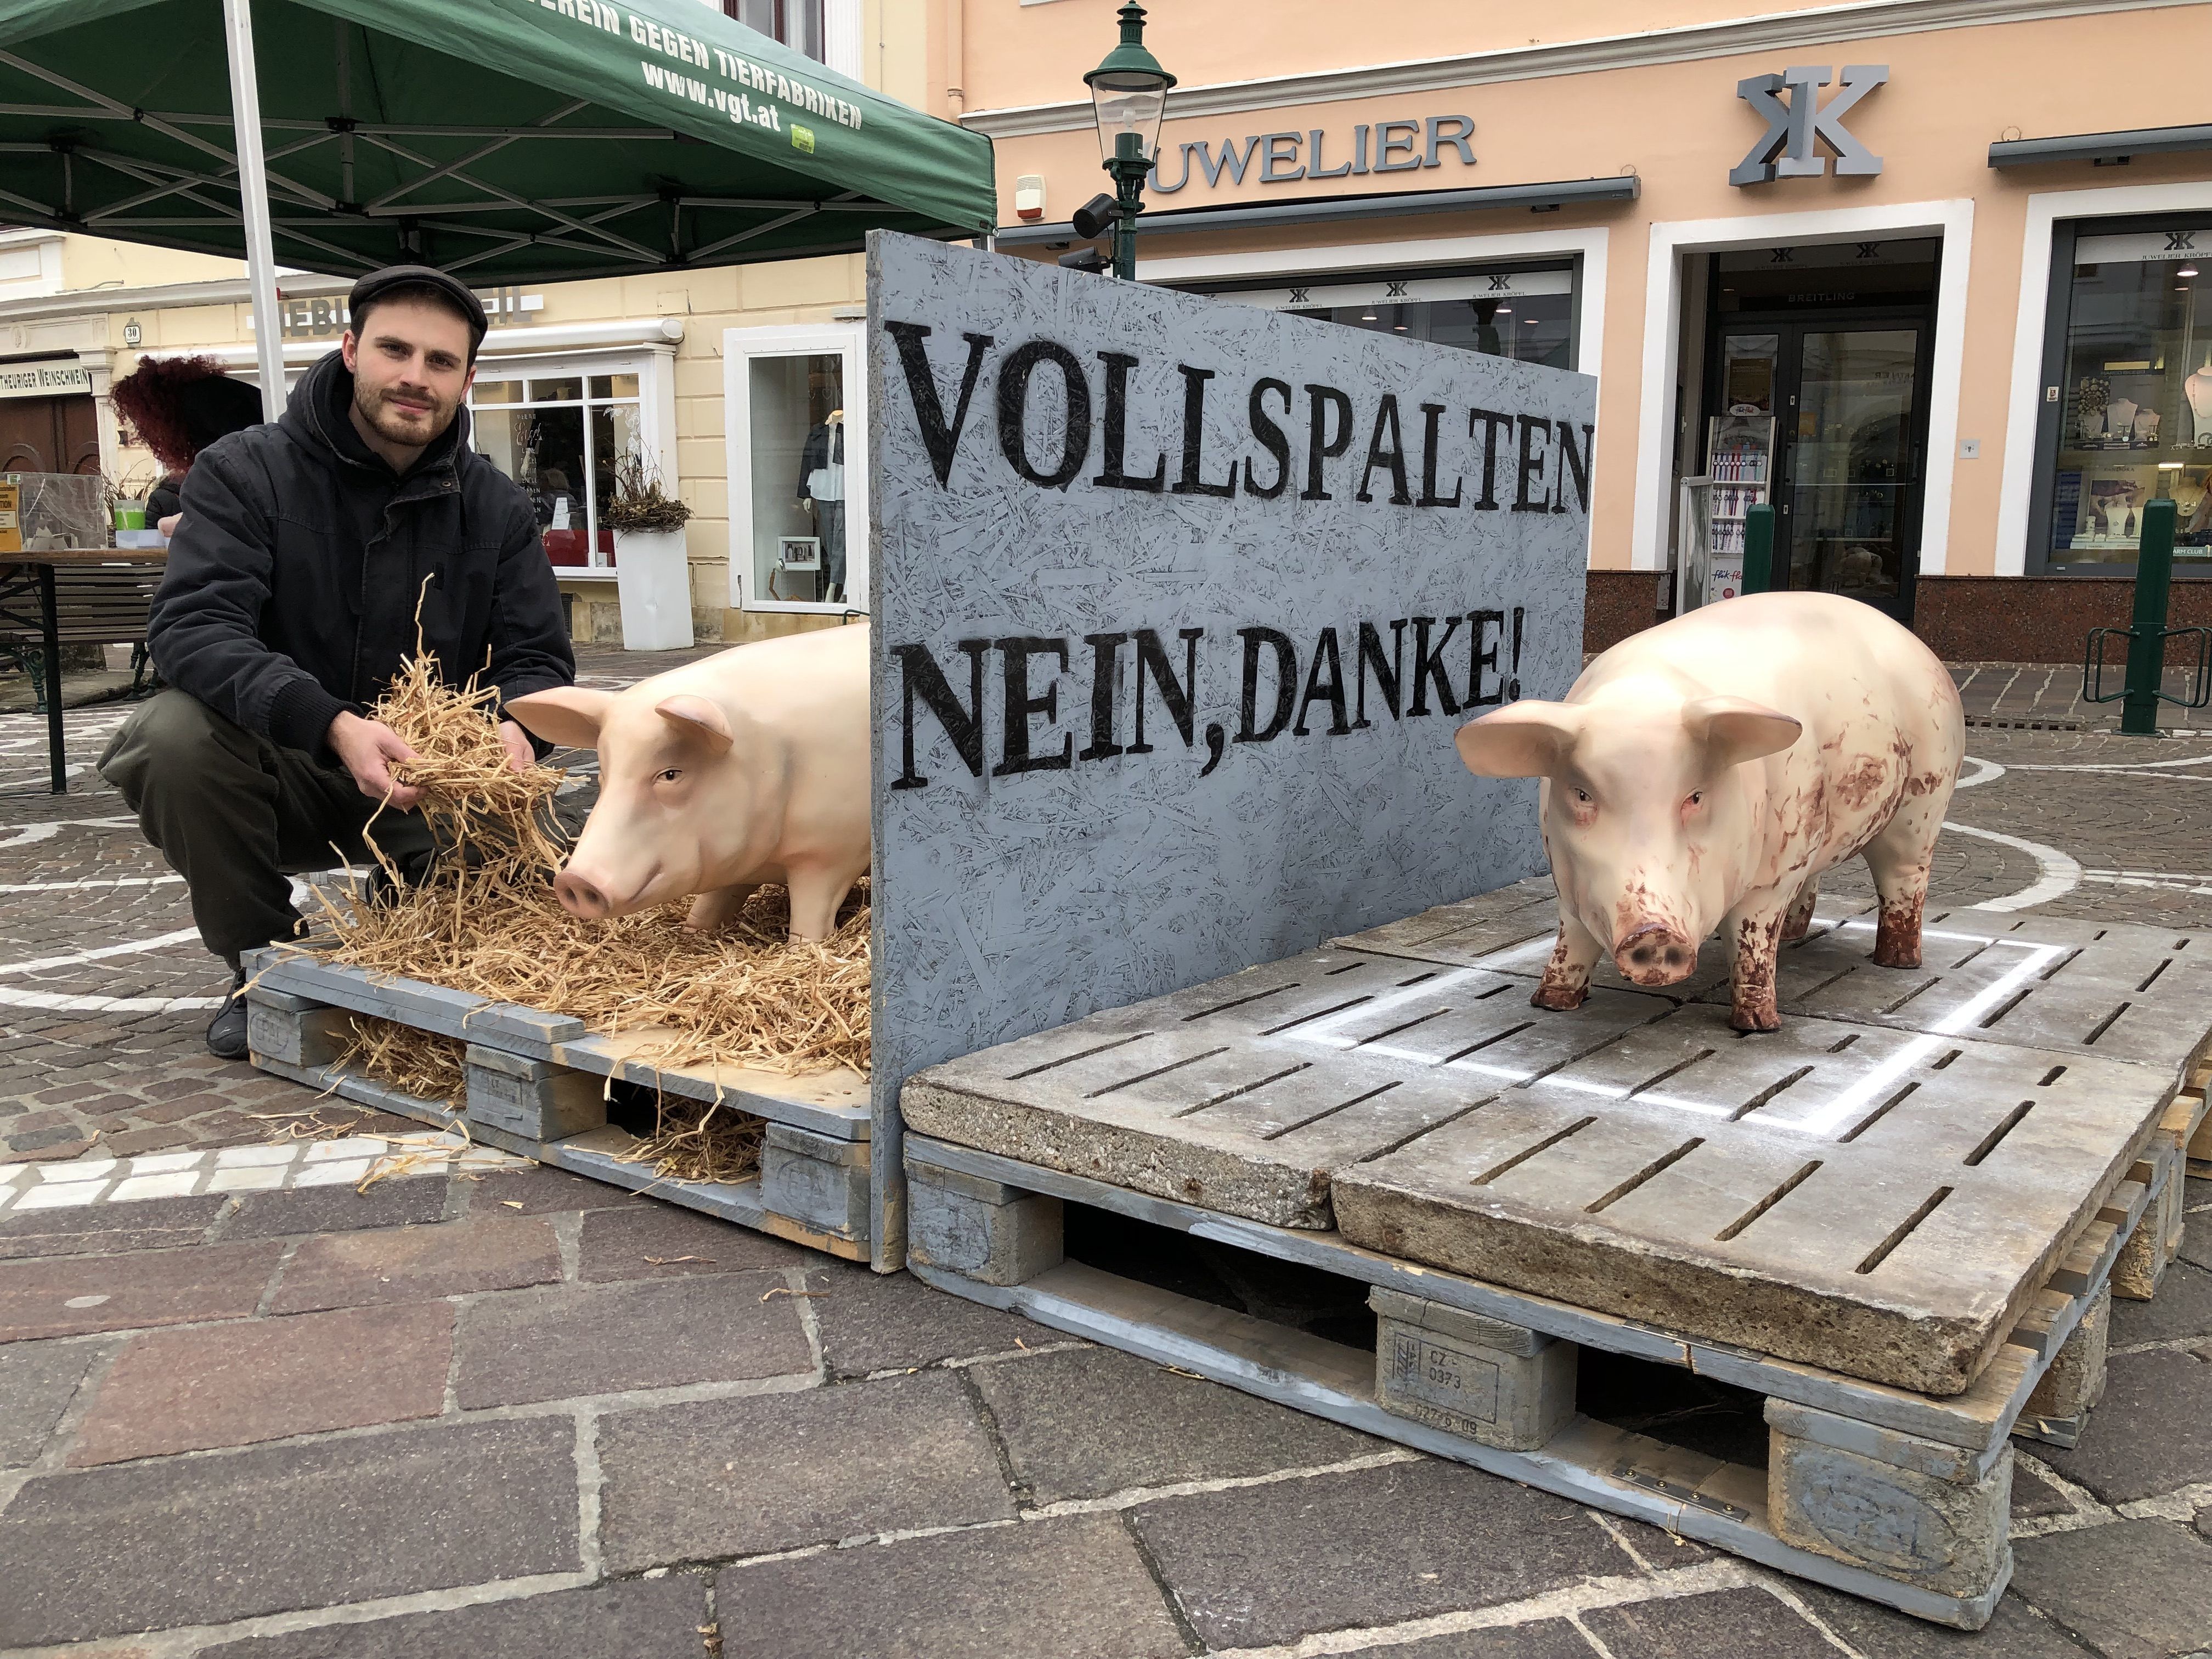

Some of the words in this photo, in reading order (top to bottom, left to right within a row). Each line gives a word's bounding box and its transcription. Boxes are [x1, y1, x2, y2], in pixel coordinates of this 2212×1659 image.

[527, 0, 620, 36] REIN
[628, 15, 710, 70] GEGEN
[713, 48, 862, 130] TIERFABRIKEN
[641, 61, 781, 132] www.vgt.at
[1148, 115, 1477, 194] UWELIER
[128, 328, 137, 337] 30
[1788, 292, 1855, 302] BREITLING
[884, 320, 1595, 514] VOLLSPALTEN
[1712, 569, 1730, 582] flik
[1730, 571, 1743, 582] fla
[1232, 607, 1524, 743] DANKE!
[1429, 1367, 1461, 1389] 0373
